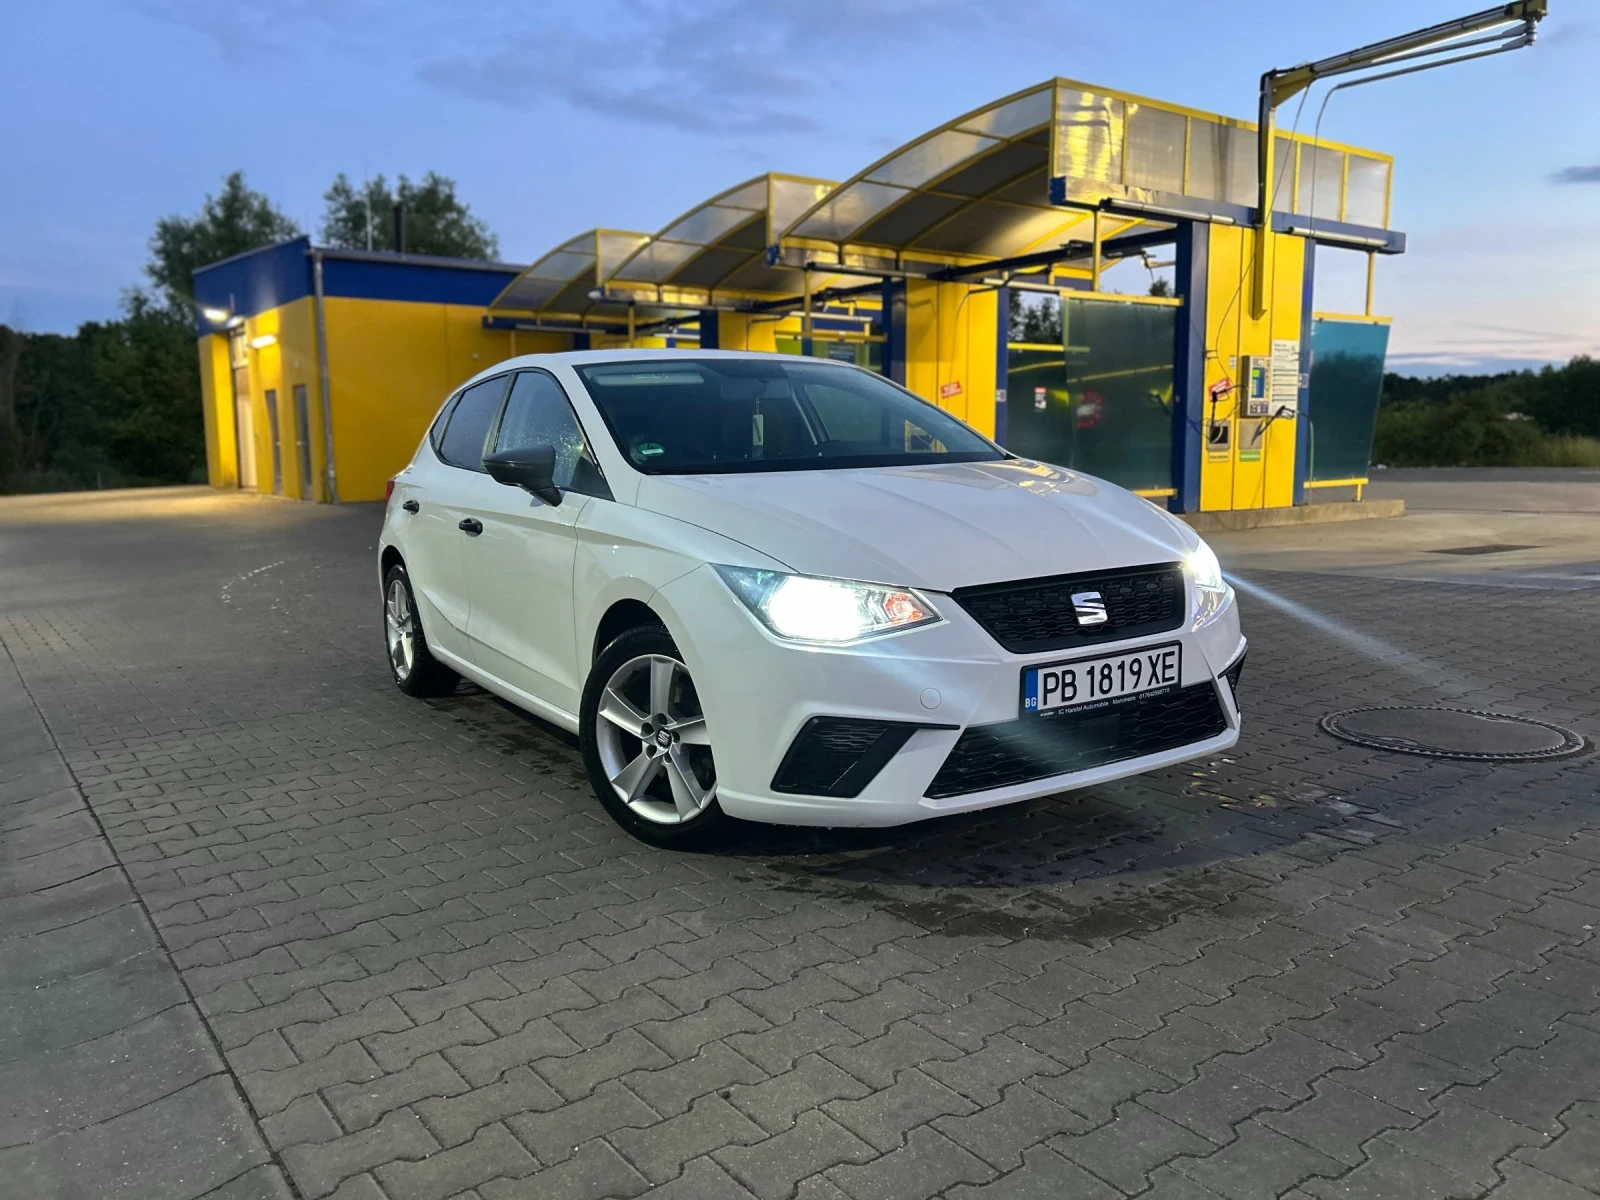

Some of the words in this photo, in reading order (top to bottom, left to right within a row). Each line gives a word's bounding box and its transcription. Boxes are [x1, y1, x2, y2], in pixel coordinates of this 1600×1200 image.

[1043, 669, 1077, 706] PB
[1025, 697, 1037, 708] BG
[1065, 706, 1082, 714] Handel
[1083, 701, 1109, 710] Automobile
